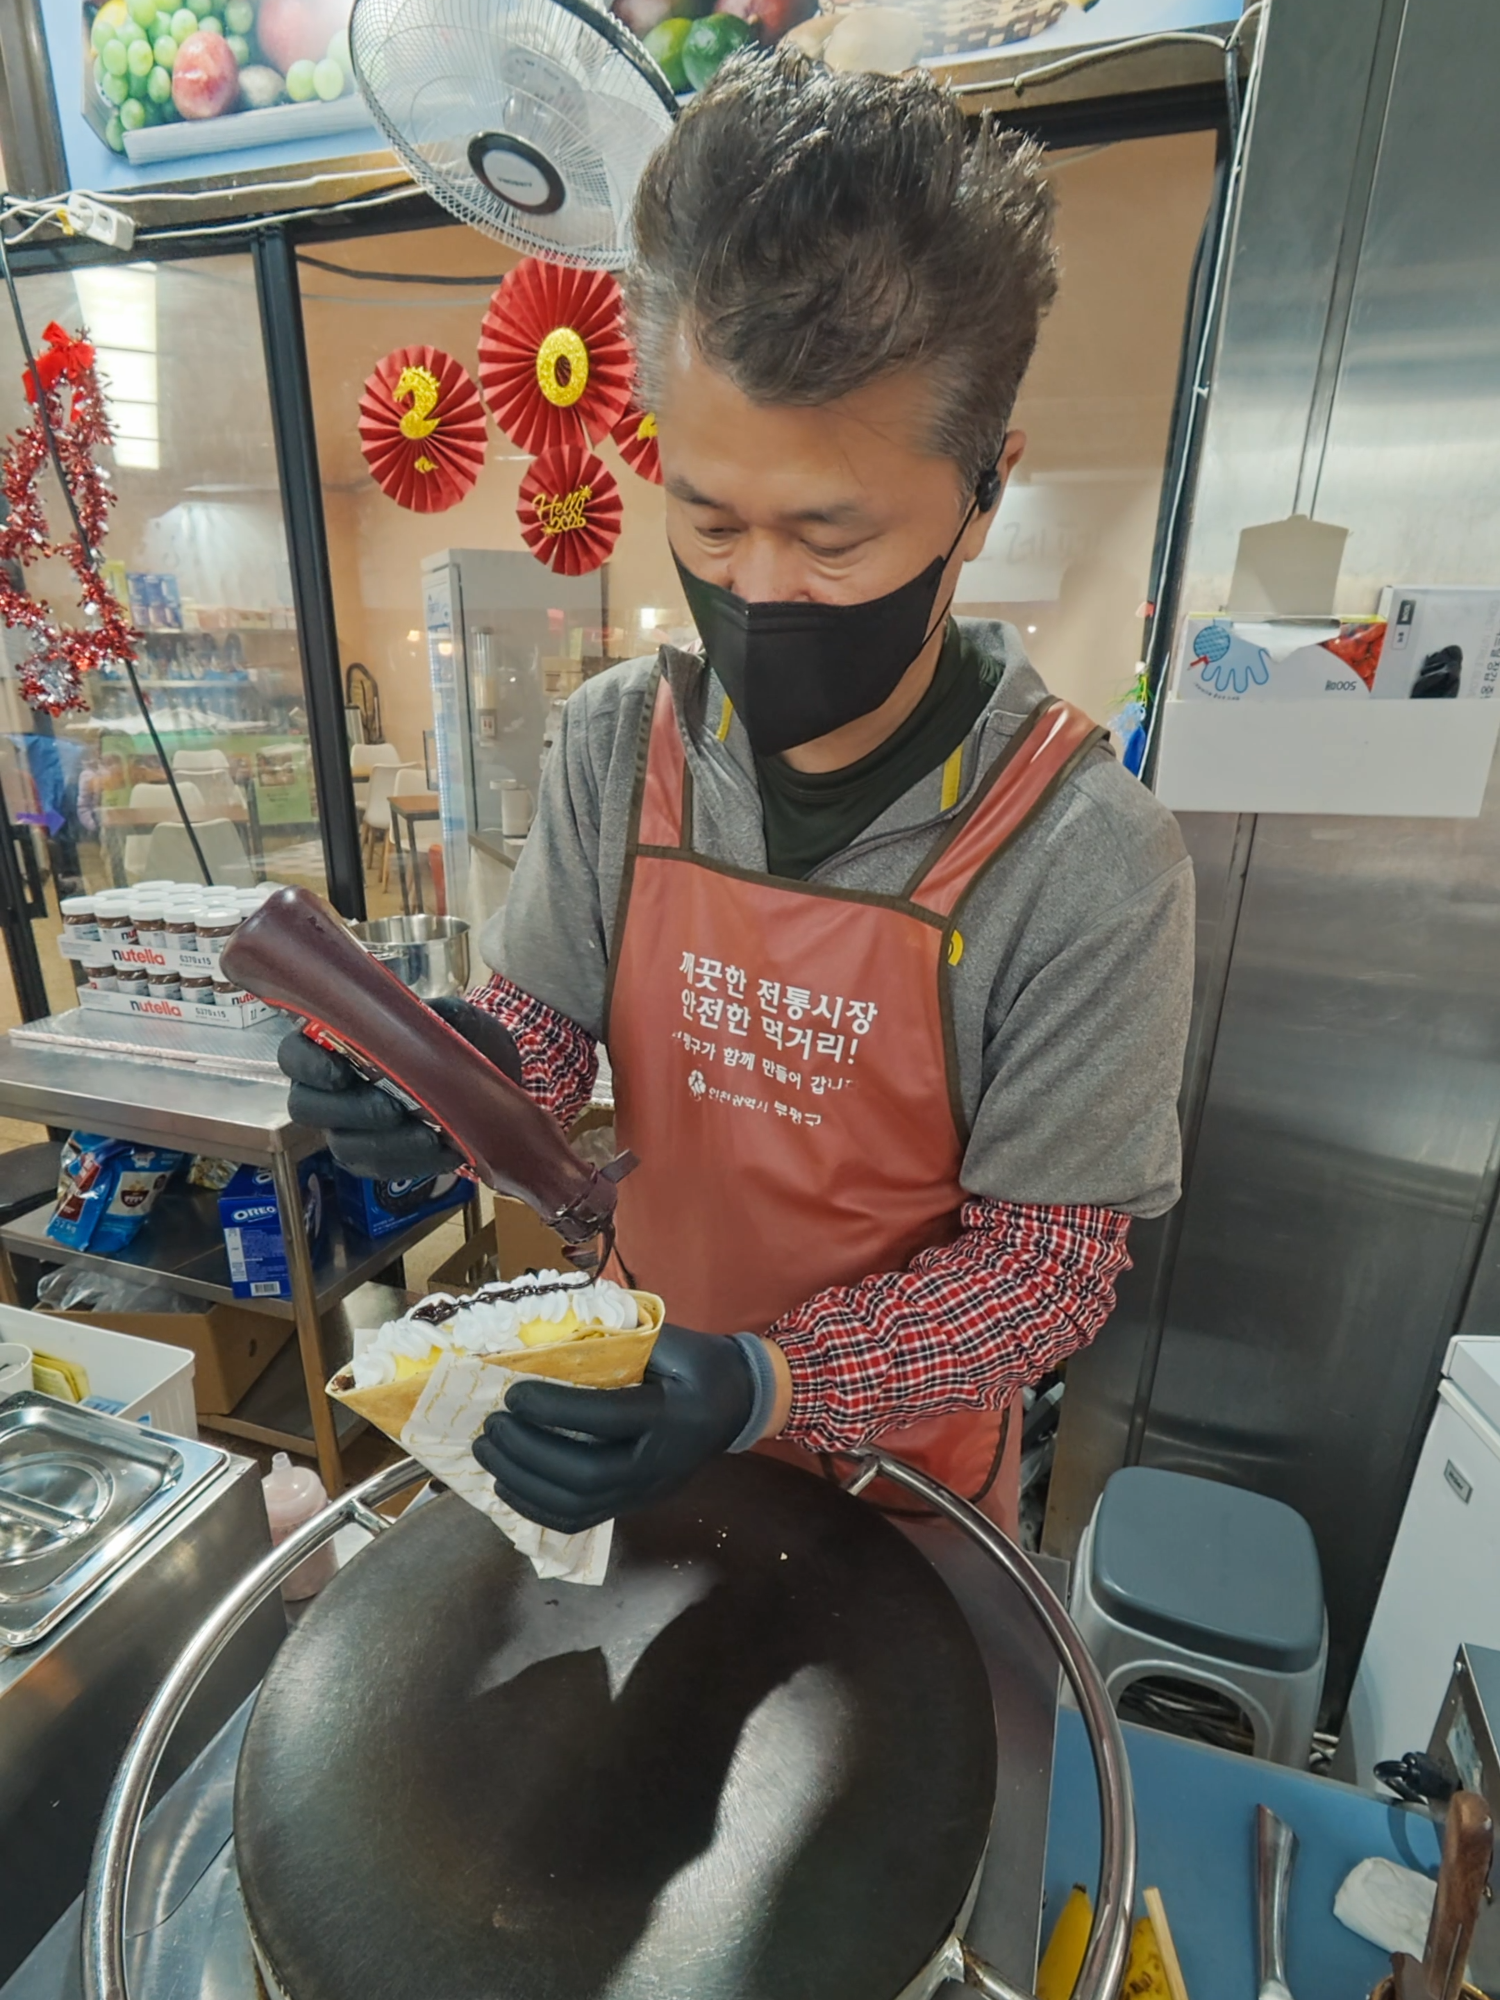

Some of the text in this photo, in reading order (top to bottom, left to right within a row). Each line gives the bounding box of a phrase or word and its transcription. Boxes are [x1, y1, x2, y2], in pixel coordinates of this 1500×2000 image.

[532, 491, 586, 525] Hello
[550, 512, 588, 534] 2026
[111, 949, 166, 966] nutella
[679, 951, 879, 1035] 깨끗한 전통시장
[130, 1000, 182, 1017] nutella
[681, 988, 860, 1066] 안전한 먹거리!
[723, 1046, 756, 1071] 함께
[762, 1057, 802, 1091] 만들어
[810, 1075, 854, 1095] 갑니
[233, 1205, 277, 1222] OREO
